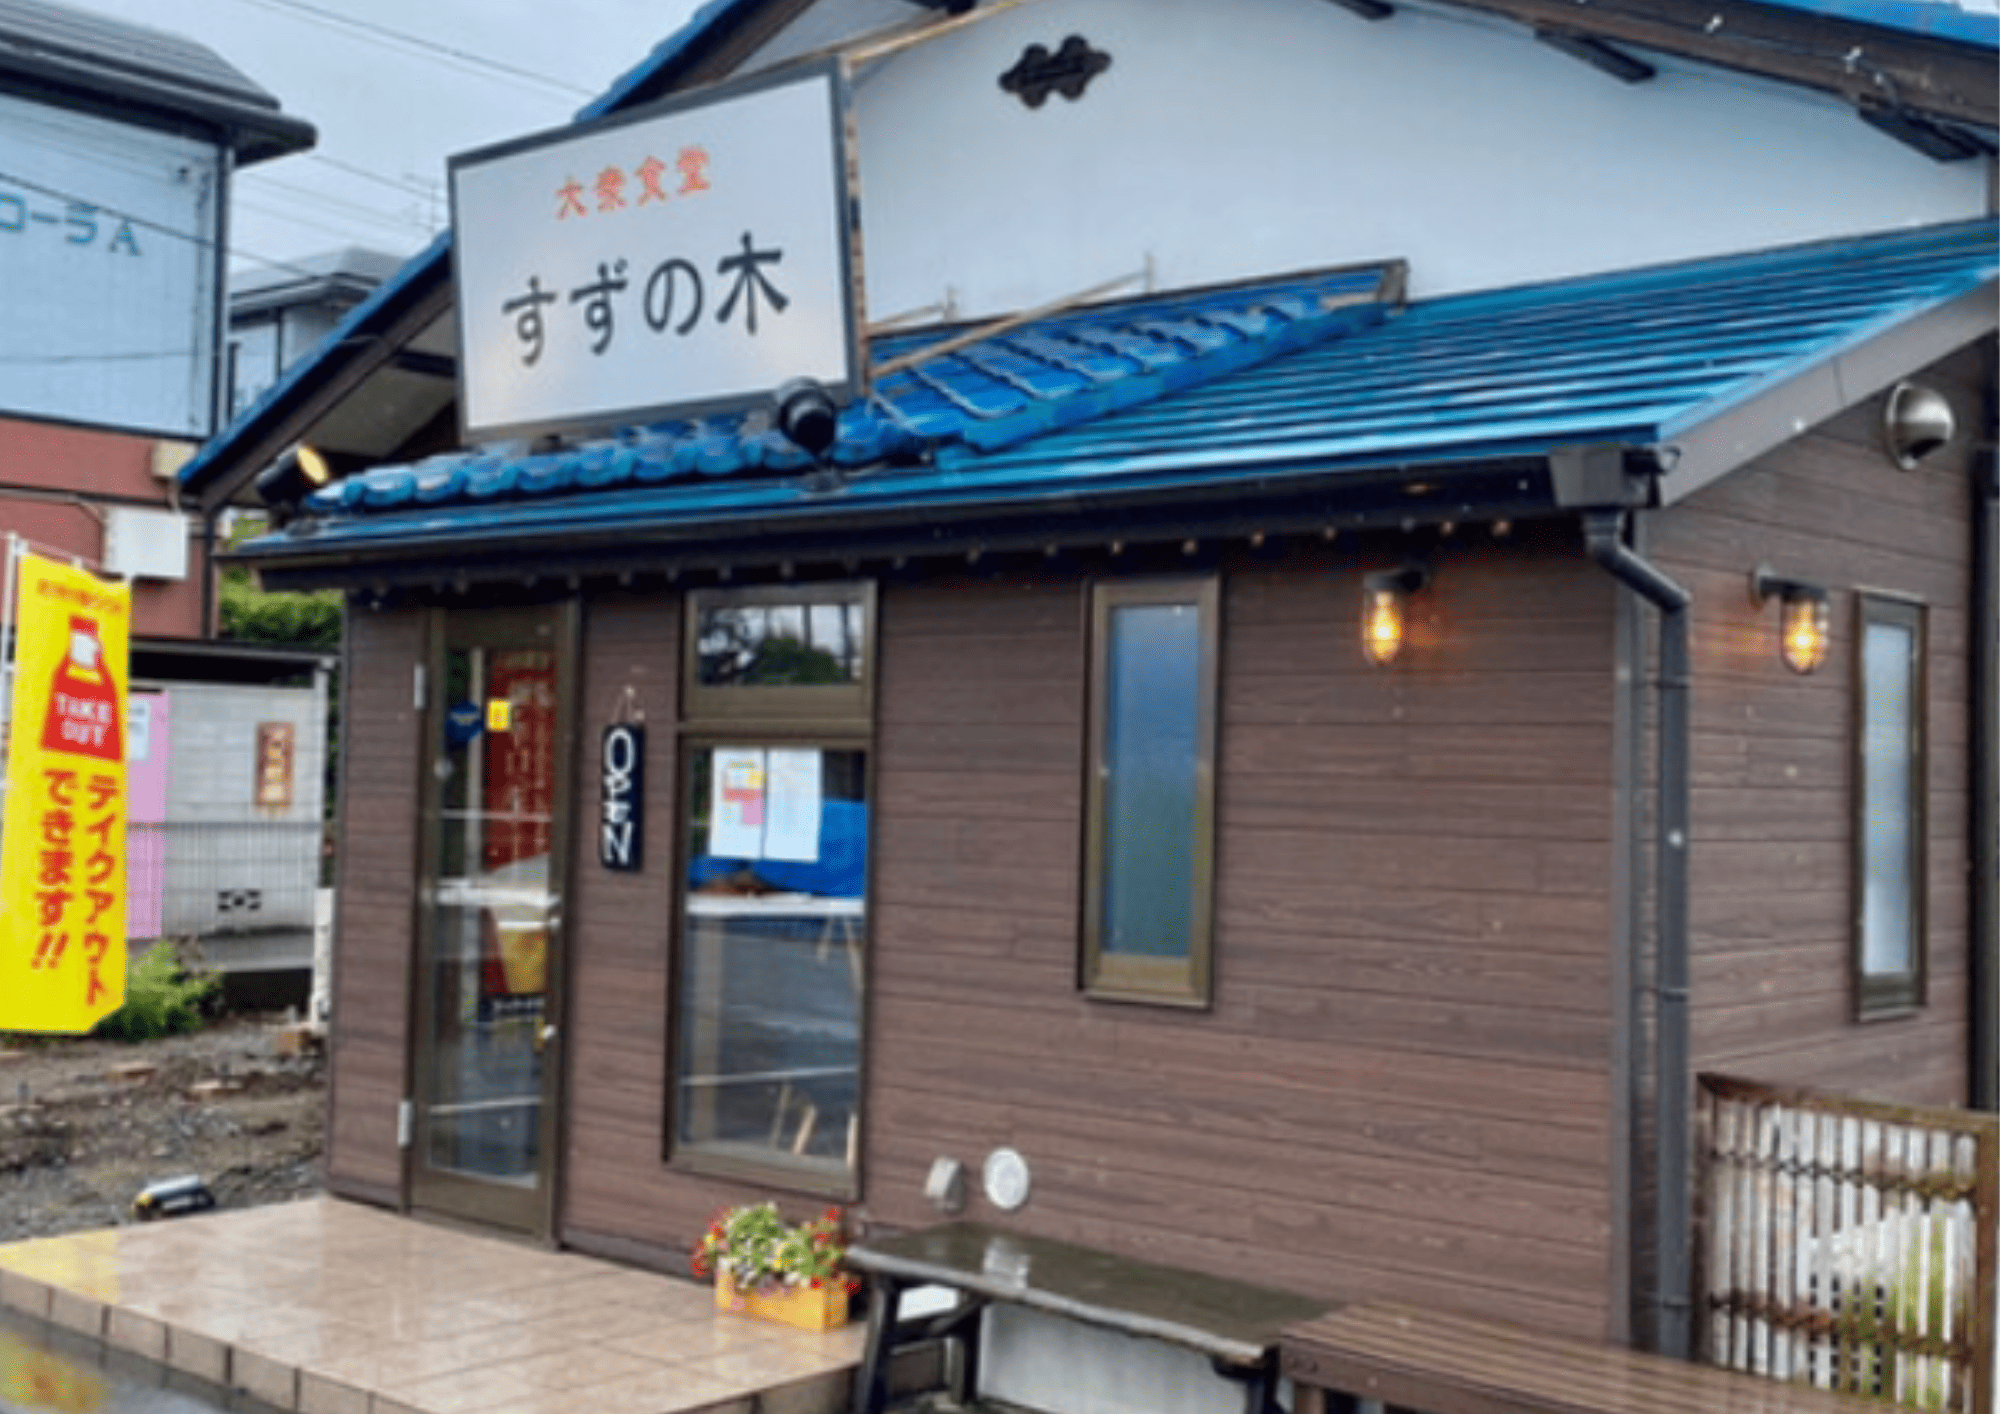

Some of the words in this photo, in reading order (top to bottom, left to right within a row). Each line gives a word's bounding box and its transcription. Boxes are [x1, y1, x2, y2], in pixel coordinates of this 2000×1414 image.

[555, 144, 711, 221] 大衆食堂
[502, 230, 790, 367] すずの木
[55, 692, 112, 724] TAKE
[62, 721, 107, 747] OUT
[604, 728, 636, 864] OPEN
[84, 774, 120, 1006] テイクアウト
